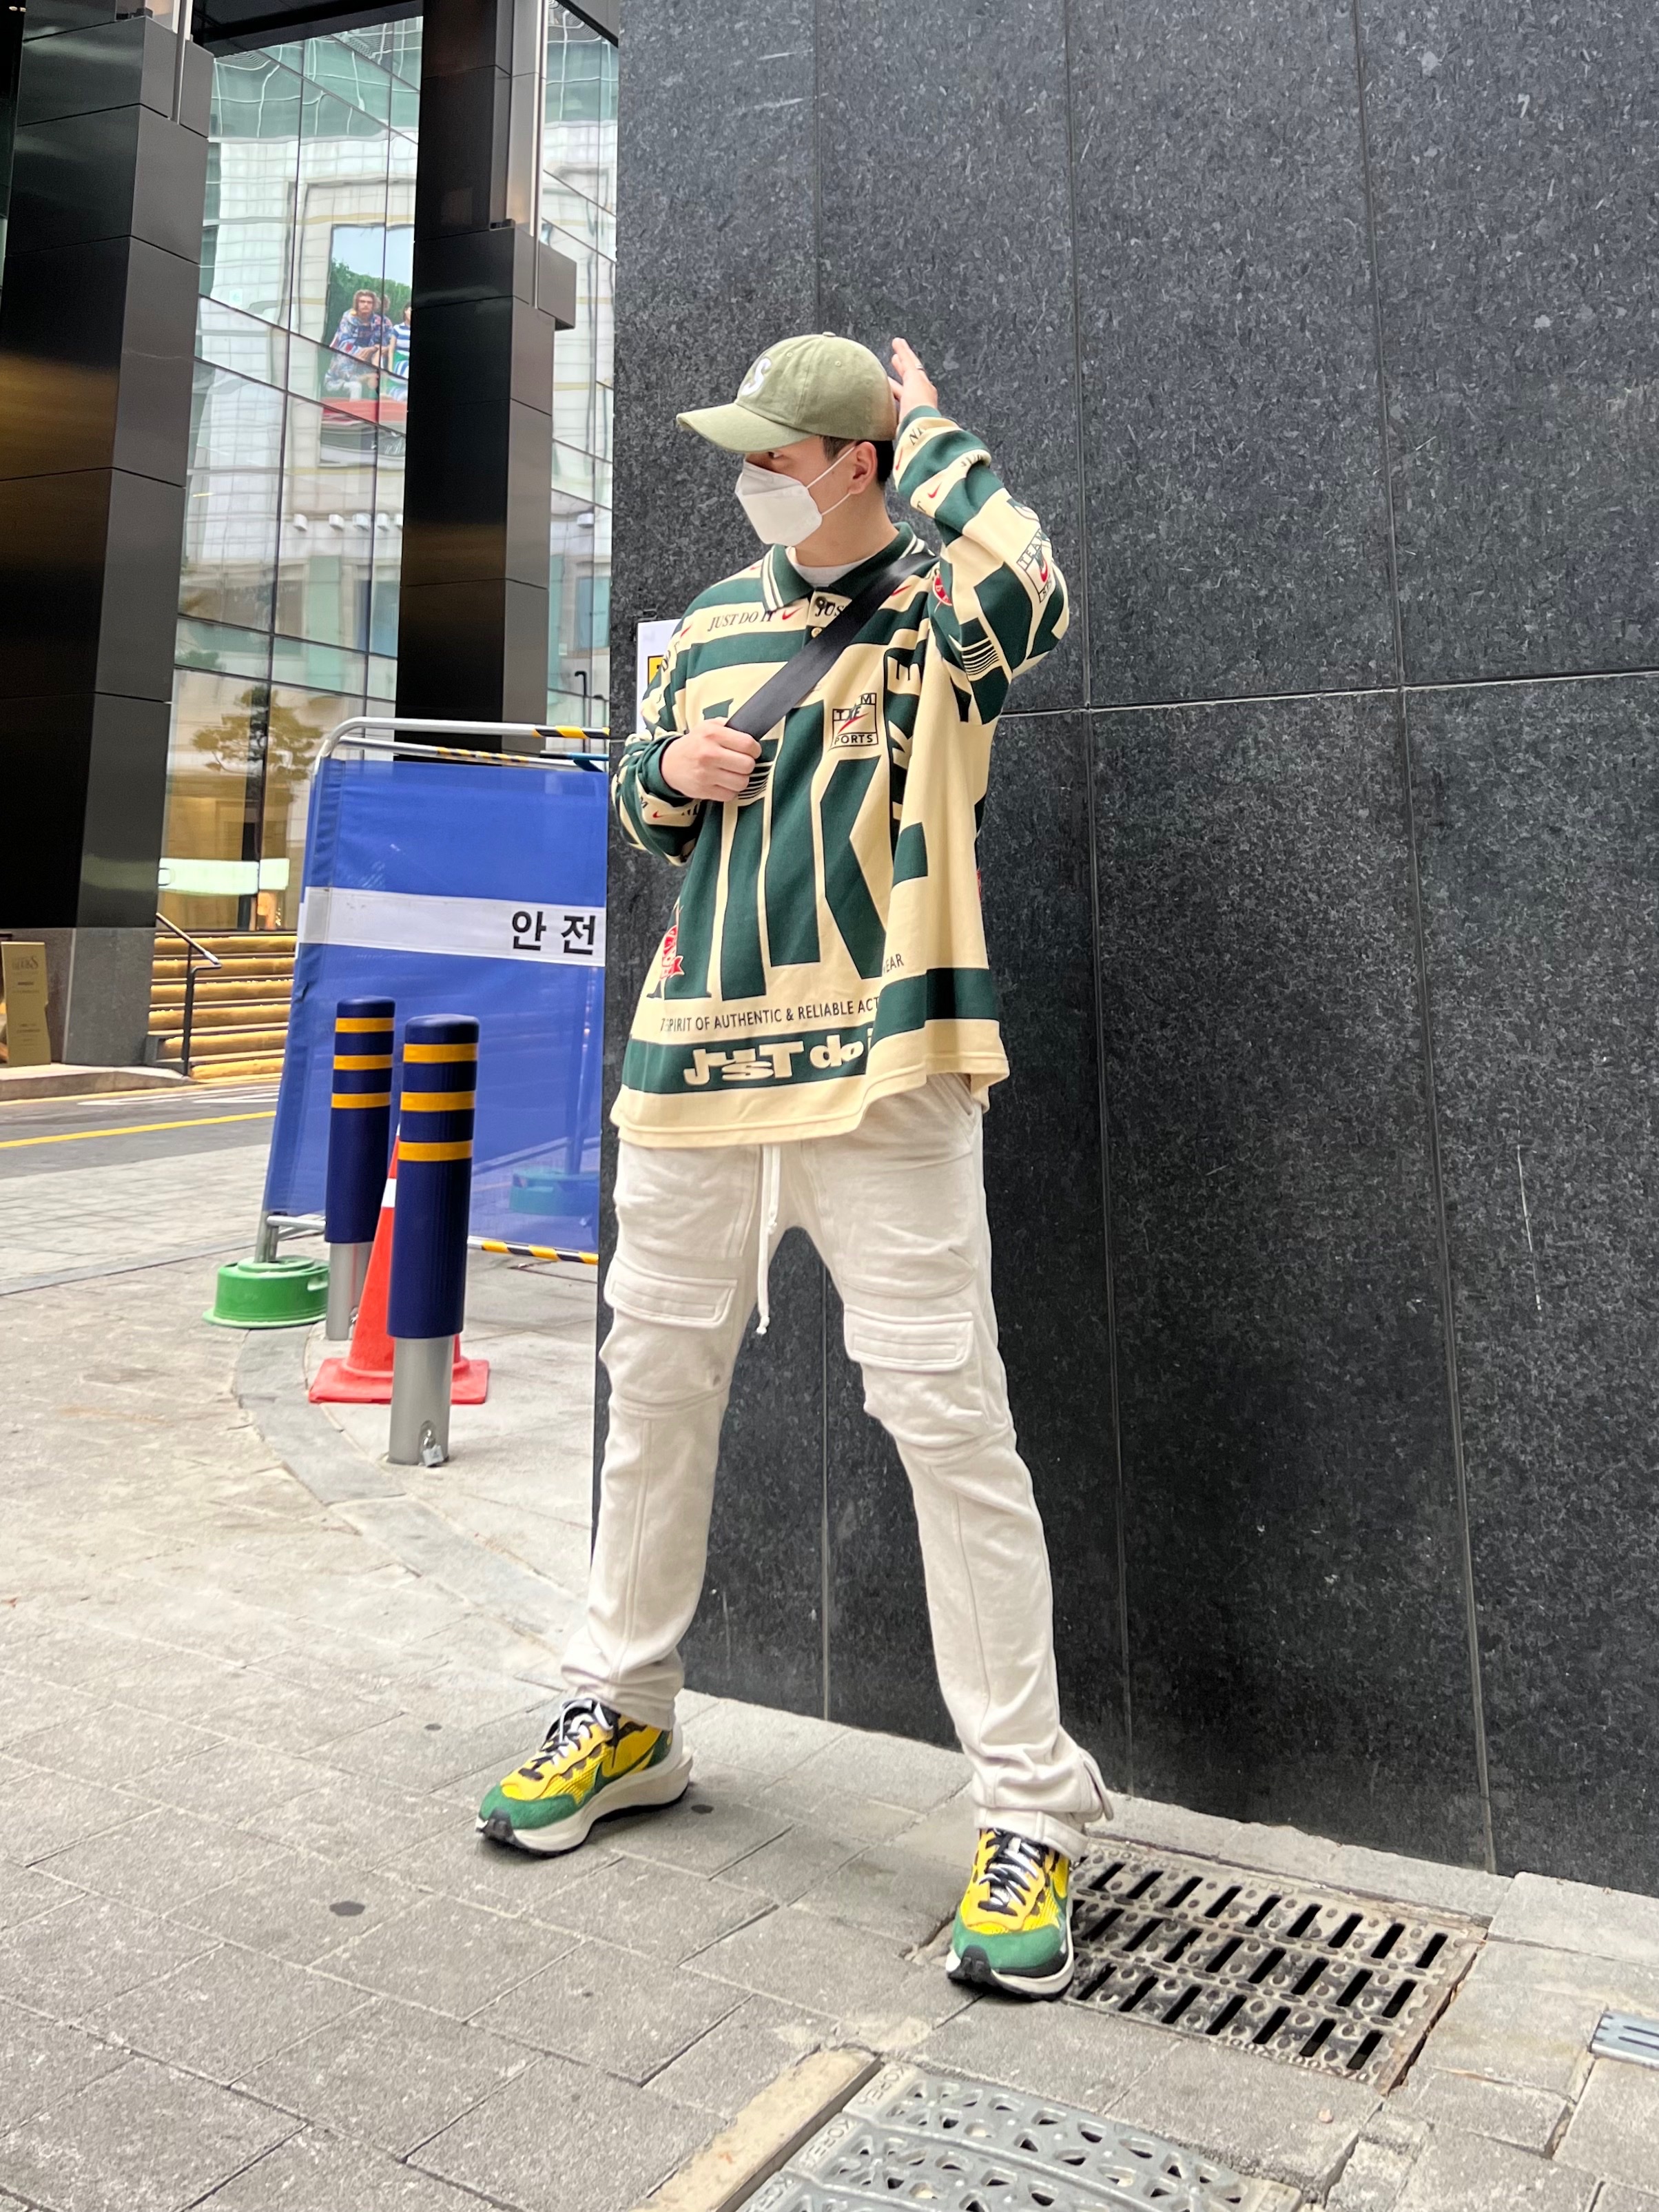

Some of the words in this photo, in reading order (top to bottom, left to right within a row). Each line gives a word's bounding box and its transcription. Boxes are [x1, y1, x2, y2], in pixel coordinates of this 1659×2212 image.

[741, 358, 772, 397] S
[707, 613, 739, 632] JUST
[739, 611, 759, 625] DO
[834, 735, 874, 746] PORTS
[883, 953, 905, 974] EAR
[695, 1016, 710, 1031] OF
[714, 1008, 782, 1030] AUTHENTIC
[786, 1007, 794, 1021] &
[798, 1000, 854, 1021] RELIABLE
[857, 996, 880, 1014] ACT
